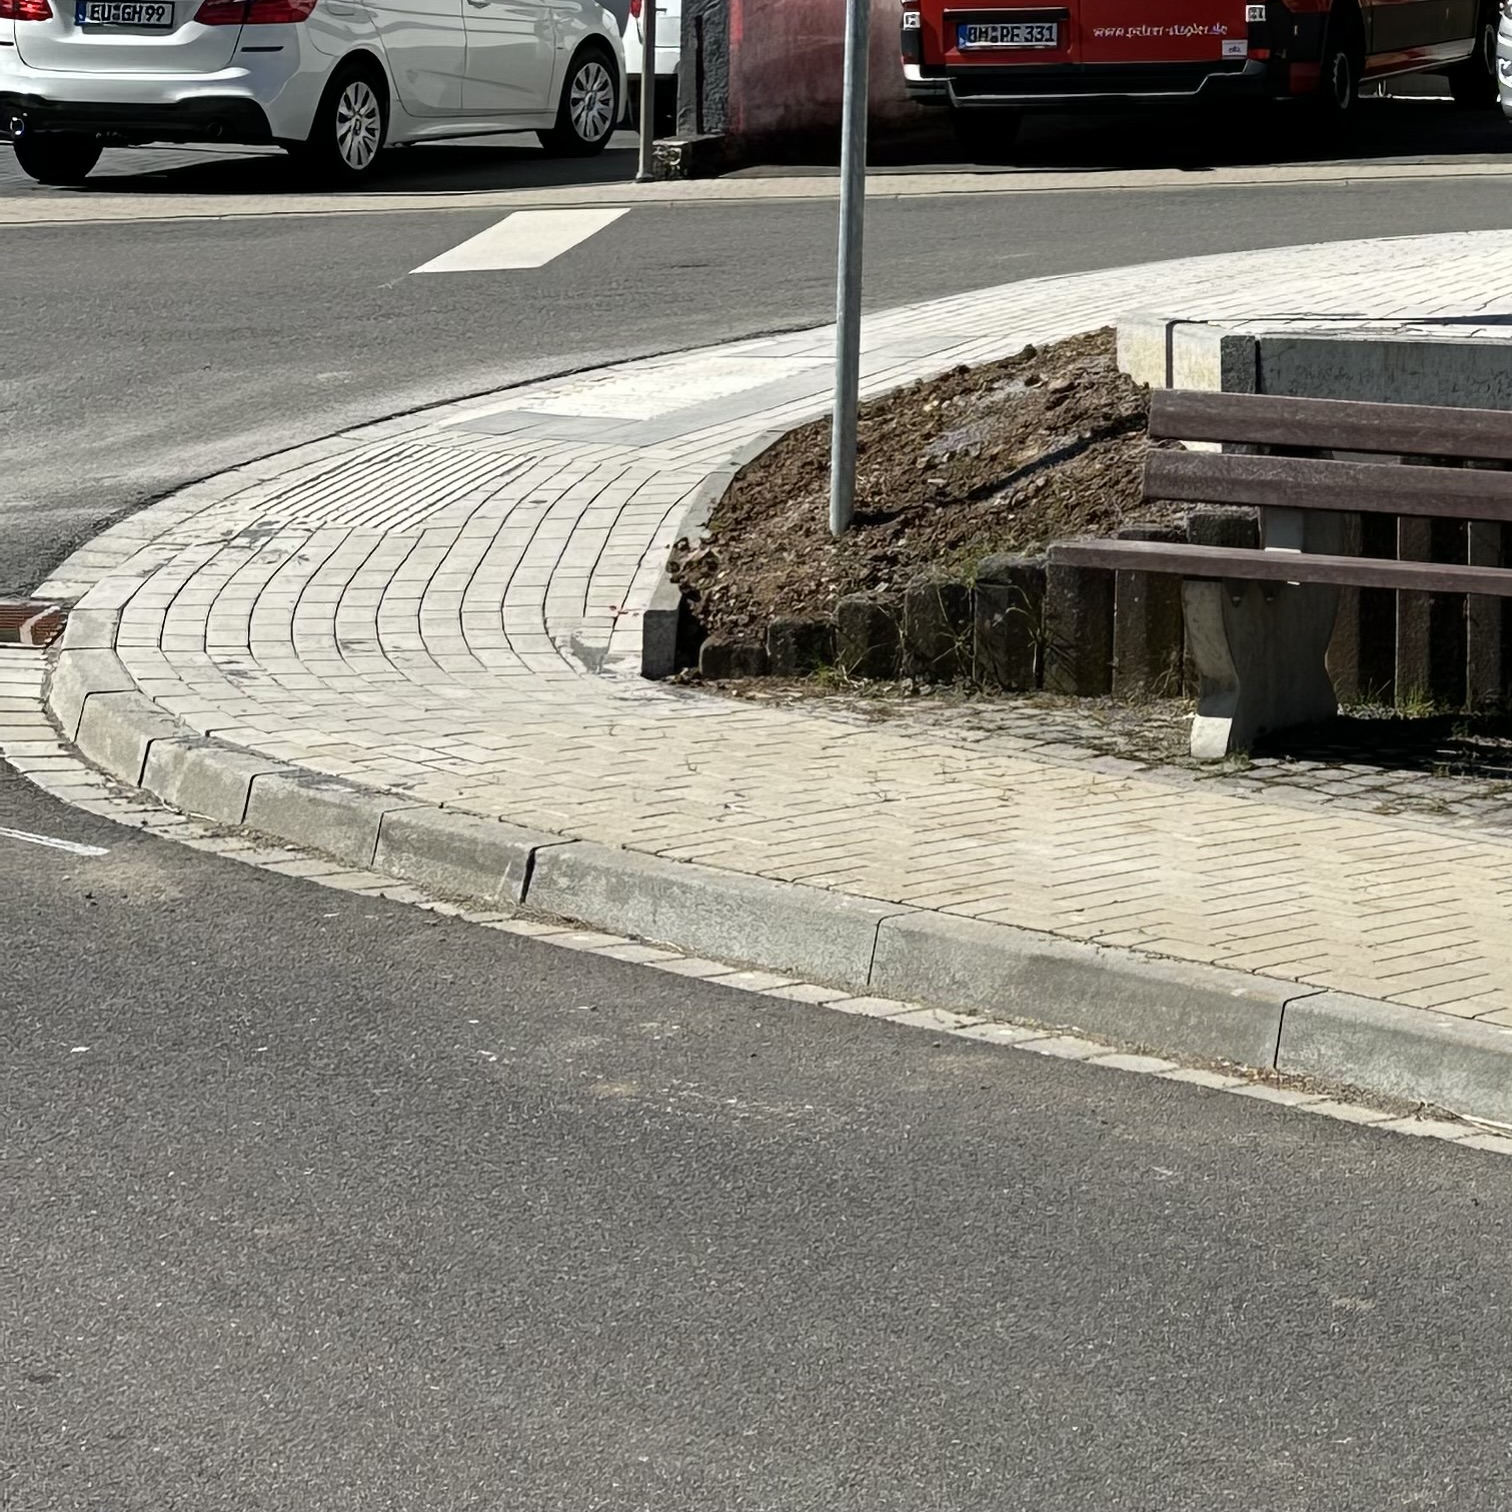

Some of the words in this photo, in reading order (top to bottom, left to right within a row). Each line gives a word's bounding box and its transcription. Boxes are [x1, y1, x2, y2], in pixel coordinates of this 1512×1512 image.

[90, 4, 112, 22] EU
[121, 4, 142, 22] GH
[145, 4, 166, 23] 99
[1023, 25, 1055, 43] 331
